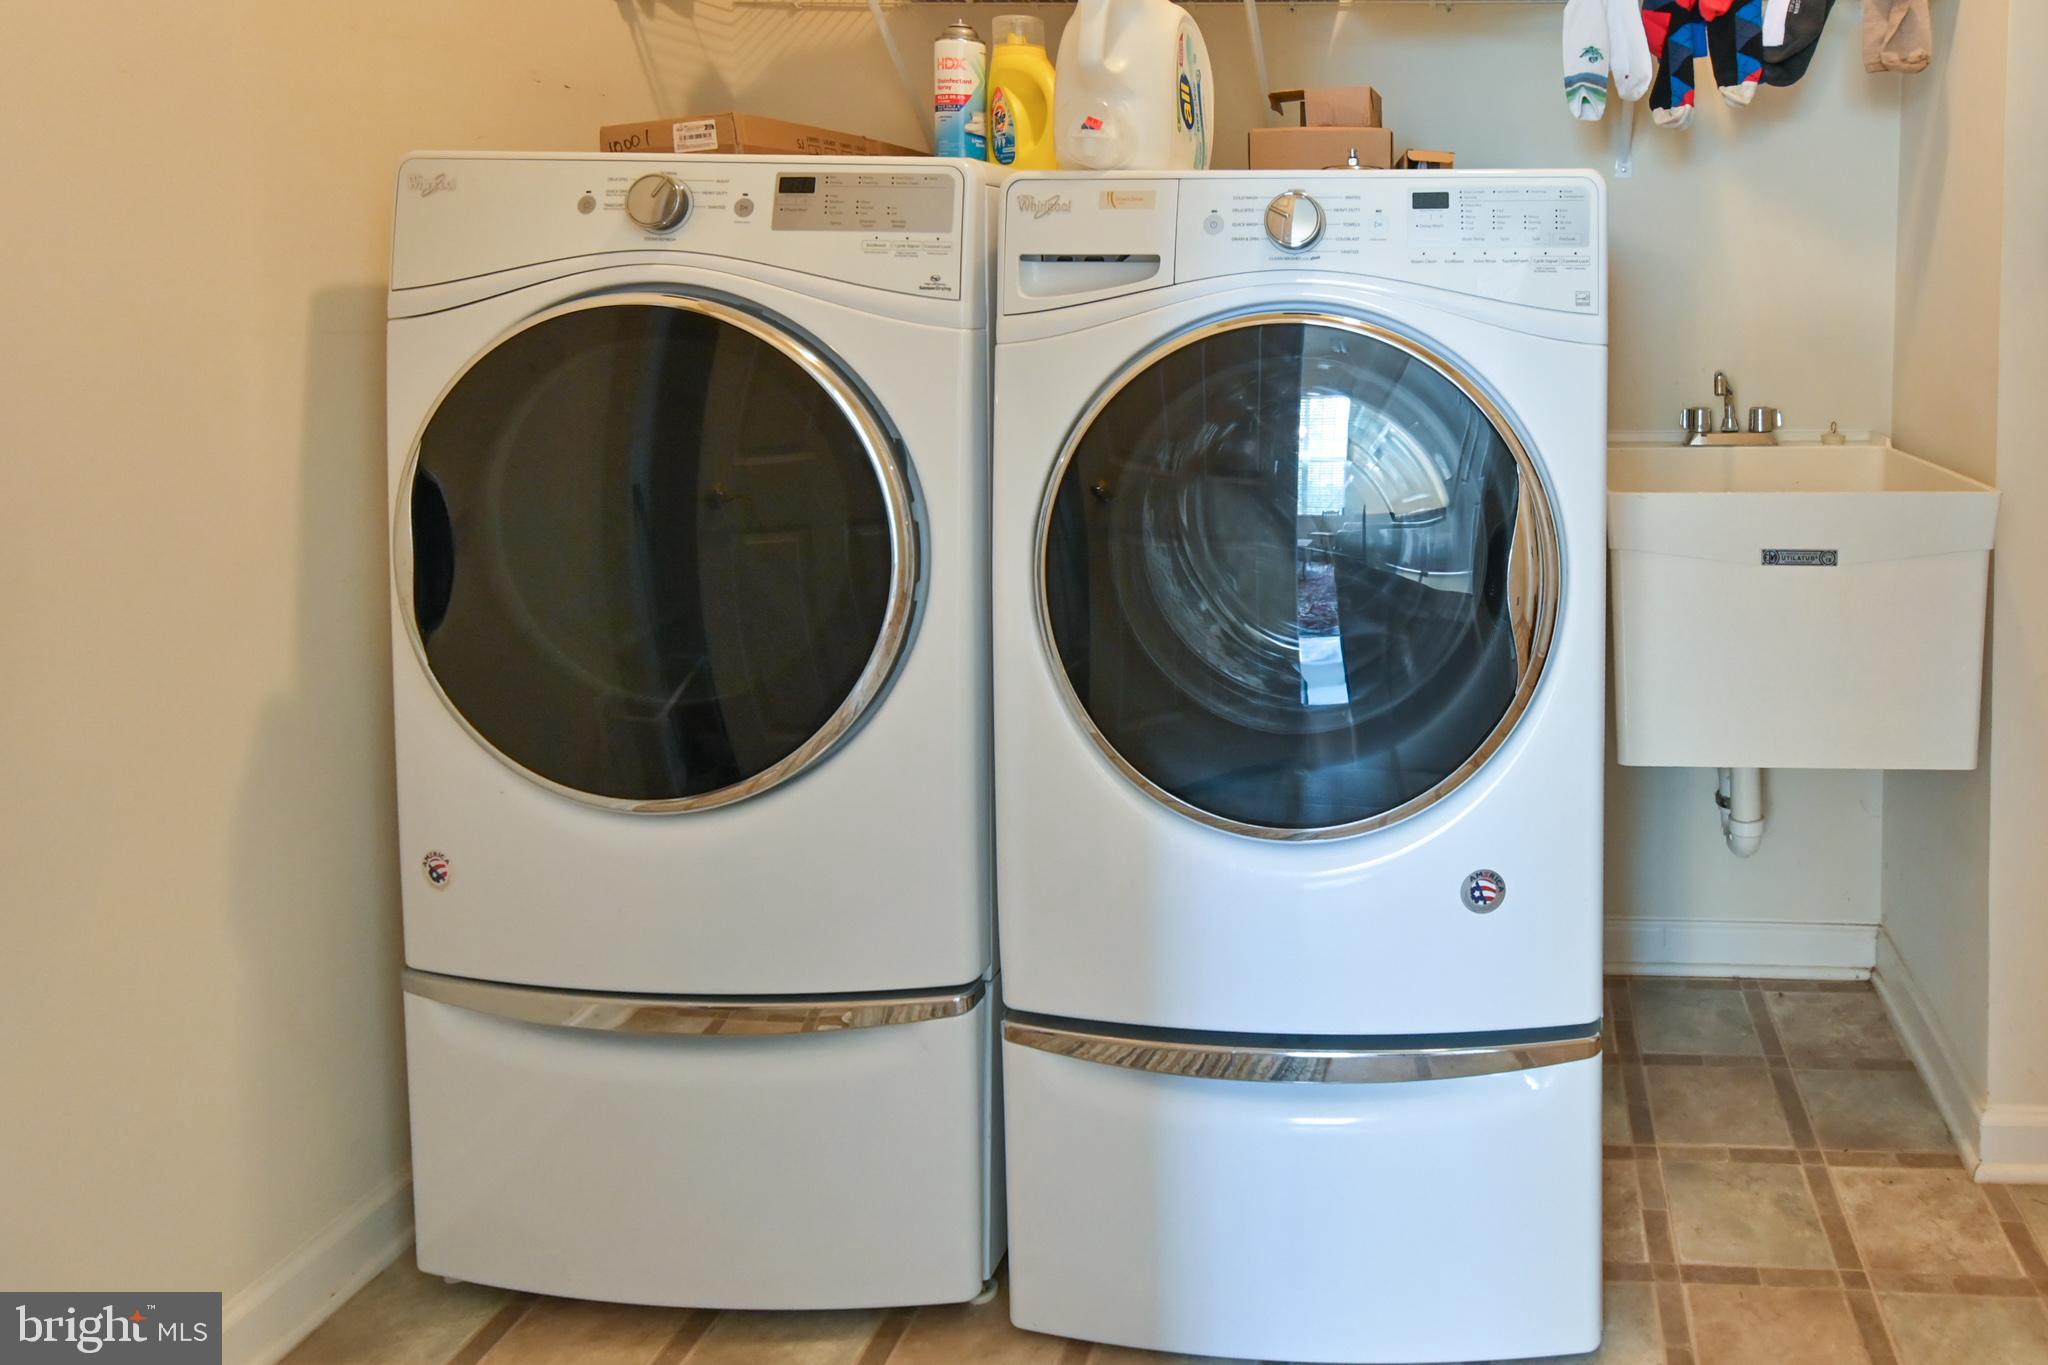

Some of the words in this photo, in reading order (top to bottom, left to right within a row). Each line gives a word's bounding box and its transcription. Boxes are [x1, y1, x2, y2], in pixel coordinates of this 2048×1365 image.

[936, 57, 966, 70] HDX
[1017, 194, 1072, 219] Whirlpool
[1469, 871, 1505, 892] AMERICA
